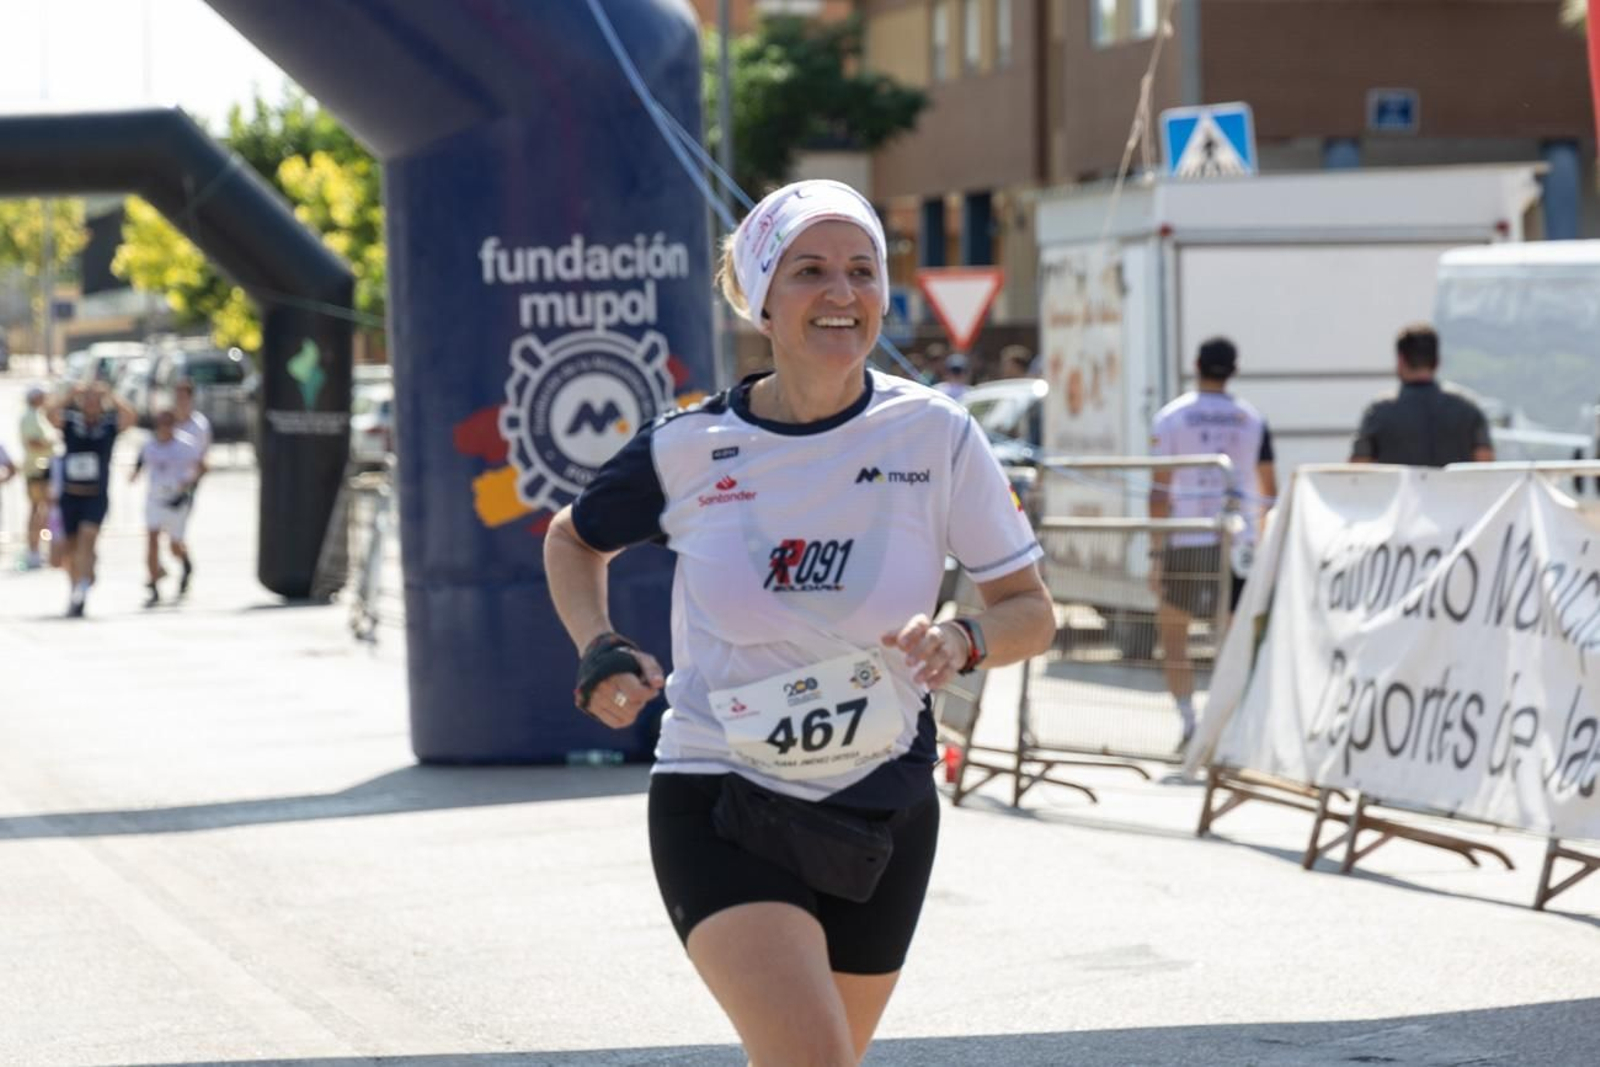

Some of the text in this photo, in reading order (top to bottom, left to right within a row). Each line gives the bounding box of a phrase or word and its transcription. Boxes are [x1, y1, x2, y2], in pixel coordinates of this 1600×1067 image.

[479, 231, 689, 284] fundación
[519, 280, 657, 332] mupol
[698, 489, 757, 507] Santander
[888, 469, 930, 486] mupol
[765, 697, 868, 754] 467
